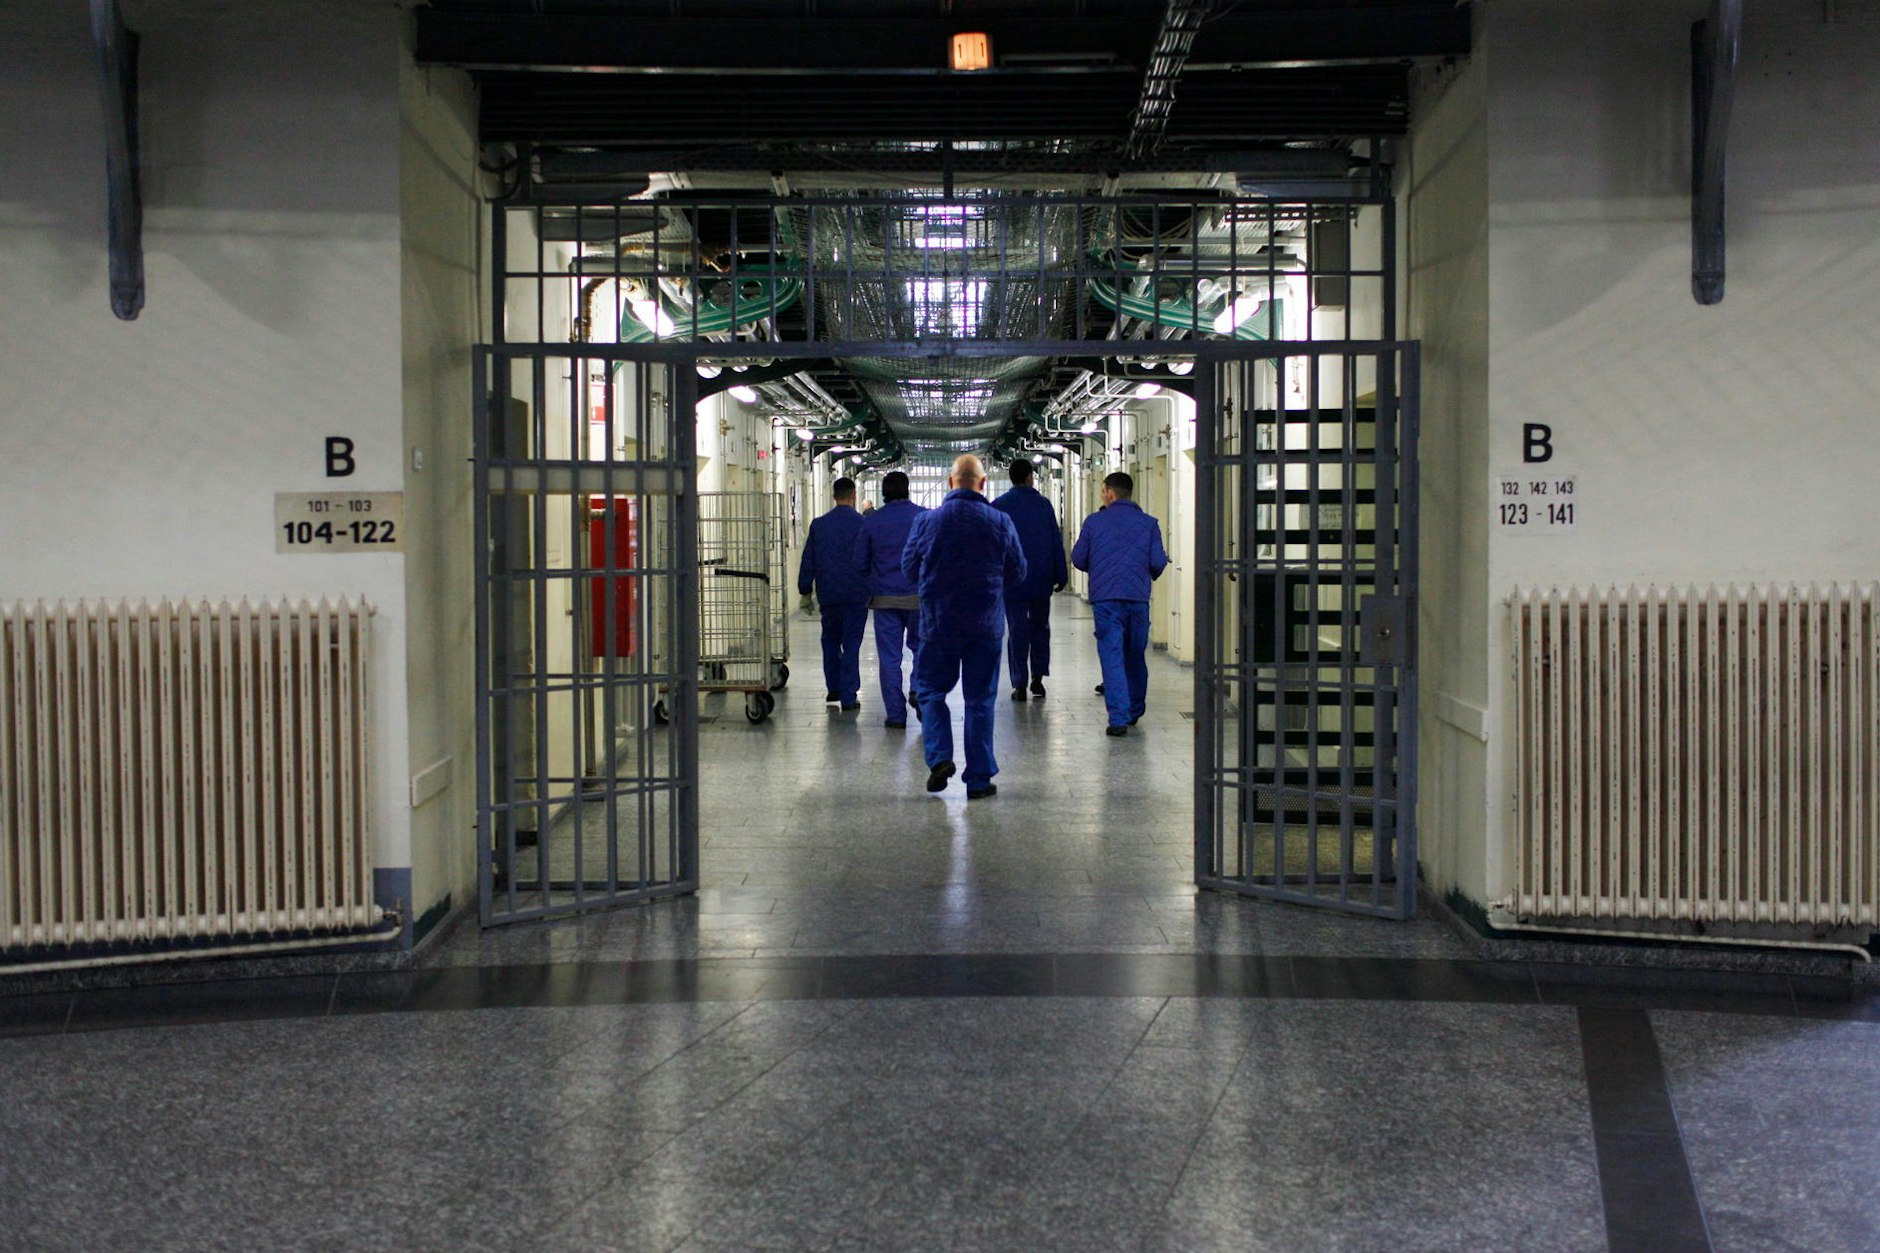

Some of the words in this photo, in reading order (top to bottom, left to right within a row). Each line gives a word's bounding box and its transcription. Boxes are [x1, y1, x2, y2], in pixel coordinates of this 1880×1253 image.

[1523, 423, 1553, 463] B
[325, 436, 355, 477] B
[1501, 482, 1519, 495] 132
[1529, 481, 1547, 495] 142
[1555, 481, 1573, 494] 143
[308, 500, 330, 512] 101
[348, 500, 372, 512] 103
[1499, 503, 1528, 525] 123
[1548, 503, 1574, 525] 141
[283, 520, 396, 544] 104-122
